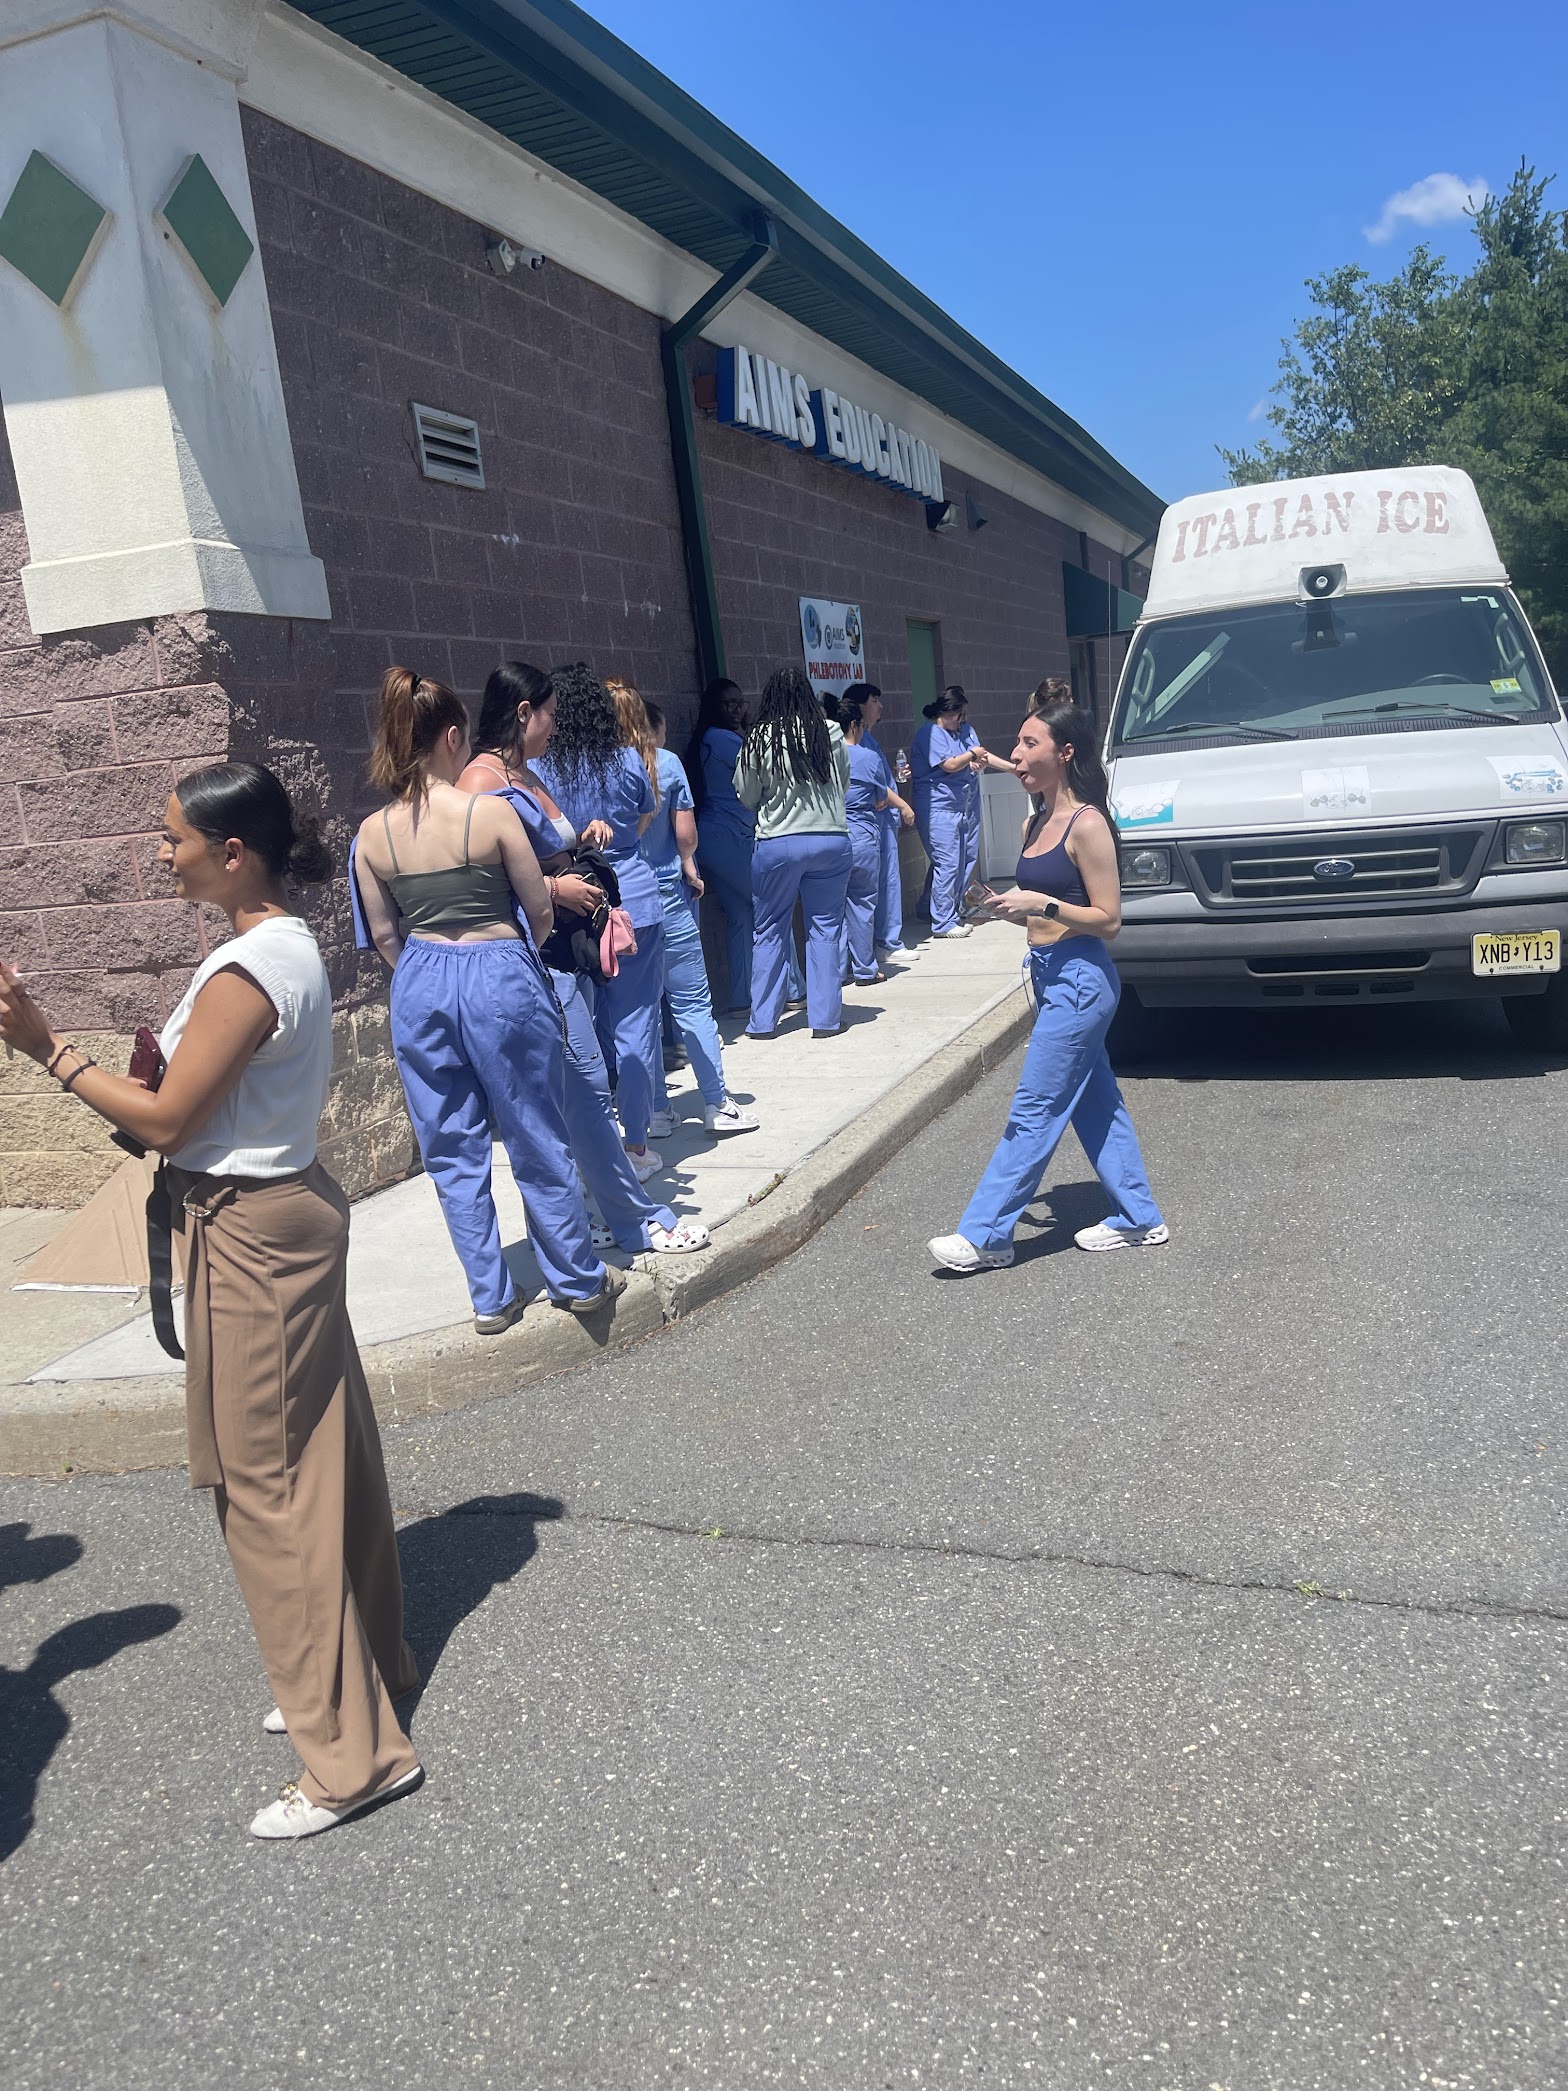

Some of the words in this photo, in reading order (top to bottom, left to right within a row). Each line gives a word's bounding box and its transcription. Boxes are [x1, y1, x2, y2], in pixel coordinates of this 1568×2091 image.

[734, 344, 816, 448] AIMS
[821, 388, 944, 503] EDUCATION
[1172, 490, 1355, 563] ITALIAN
[1376, 490, 1450, 535] ICE
[808, 661, 851, 680] PHLEBOTOMY
[853, 663, 863, 680] LAB
[1514, 934, 1538, 942] Jersey
[1480, 943, 1511, 964] XNB
[1523, 941, 1554, 961] Y13
